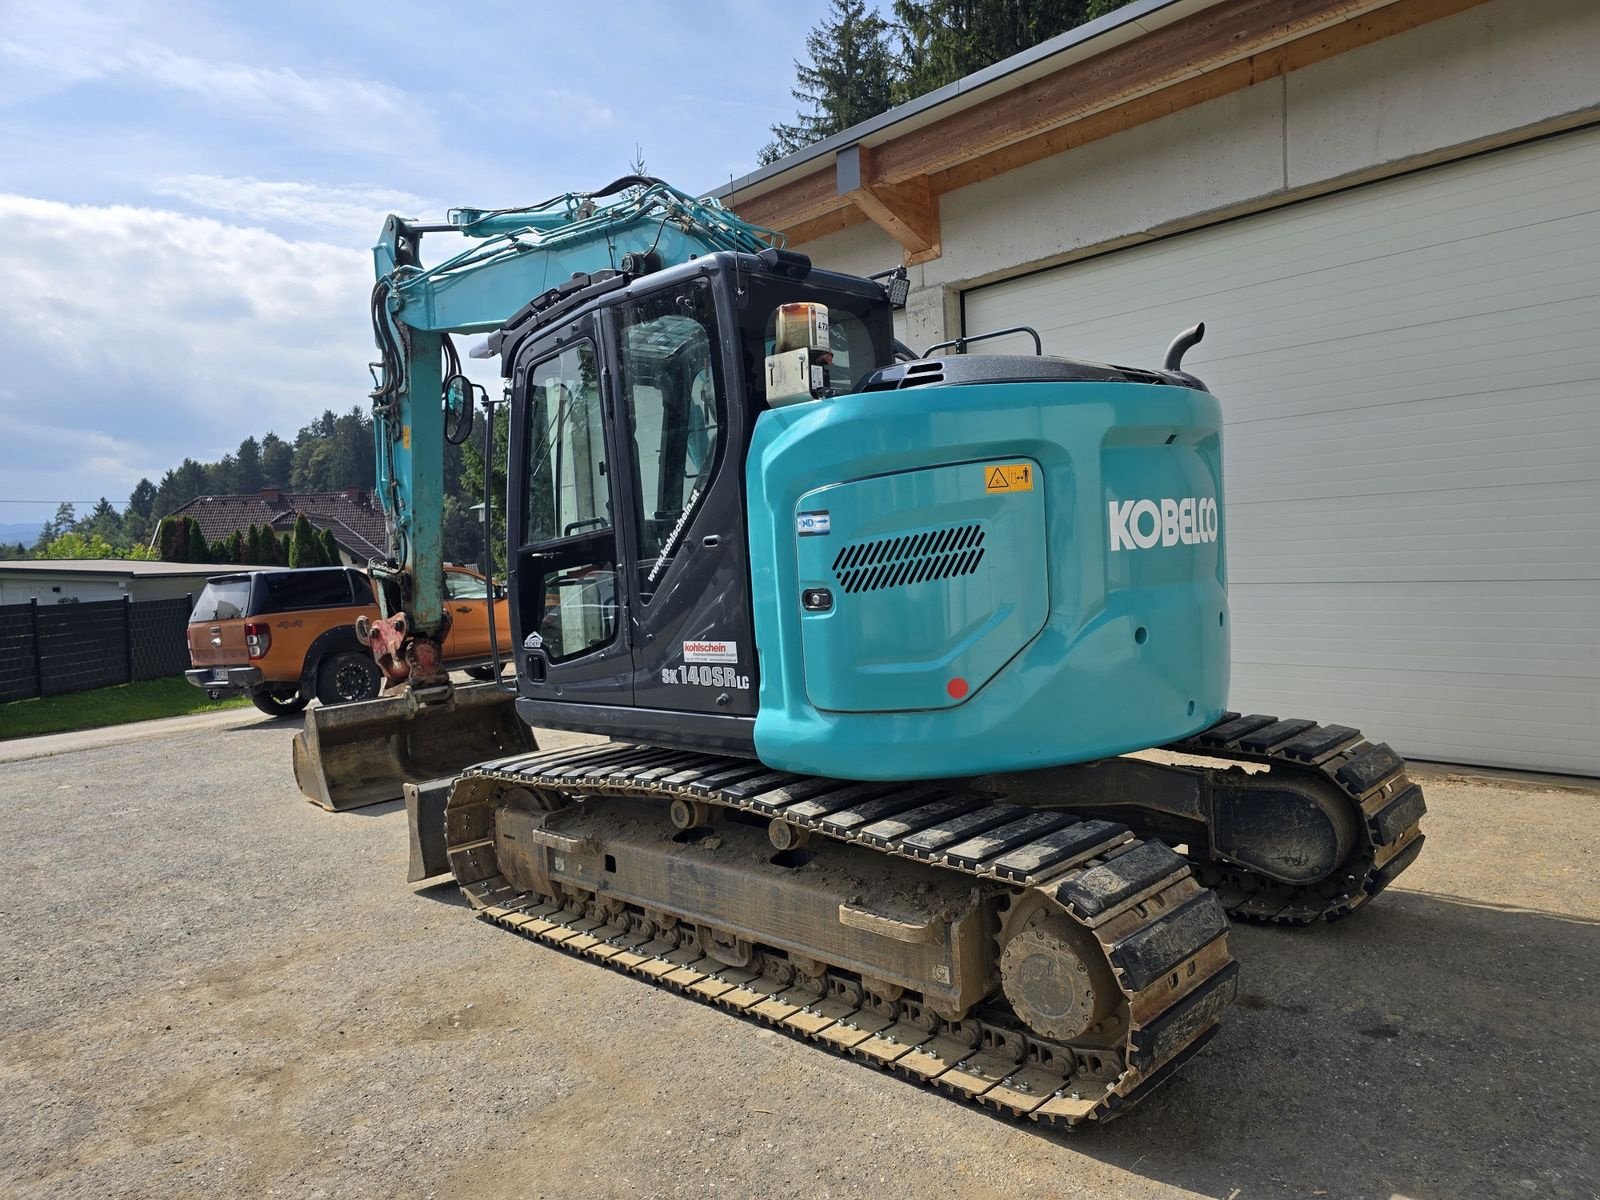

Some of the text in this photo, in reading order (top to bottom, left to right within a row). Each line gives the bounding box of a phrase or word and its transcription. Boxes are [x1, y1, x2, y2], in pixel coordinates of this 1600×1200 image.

[647, 489, 700, 582] www.kohlschein.at
[1108, 497, 1218, 551] KOBELCO
[684, 643, 726, 653] kohlschein
